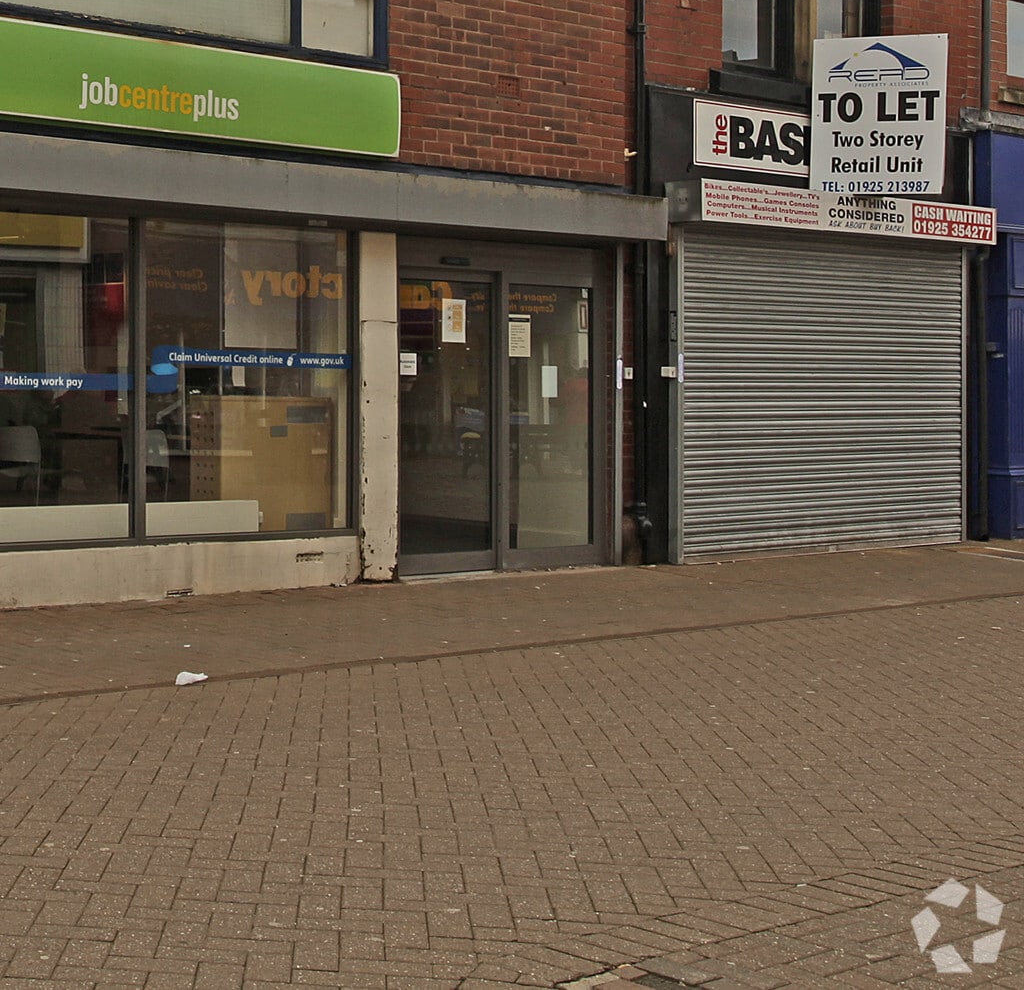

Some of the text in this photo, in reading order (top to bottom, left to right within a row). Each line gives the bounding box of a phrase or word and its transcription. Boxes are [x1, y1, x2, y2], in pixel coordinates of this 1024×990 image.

[828, 67, 930, 82] READ
[818, 90, 940, 123] TO LET
[712, 114, 728, 155] the
[832, 130, 924, 150] Two Storey
[831, 156, 923, 173] Retail Unit
[822, 181, 930, 192] TEL: 01925 213987
[705, 192, 730, 200] Mobile
[789, 200, 820, 209] Consoles
[837, 196, 897, 210] ANYTHING
[706, 209, 728, 217] Power
[784, 216, 819, 225] Equipment
[779, 207, 818, 217] Instruments
[828, 208, 905, 224] CONSIDERED
[914, 205, 991, 225] CASH WAITING
[884, 224, 905, 233] BACK!
[913, 220, 992, 240] 01925 354277
[169, 352, 344, 367] Claim Universal Credit online www.gov.uk
[4, 375, 83, 388] Making work pay
